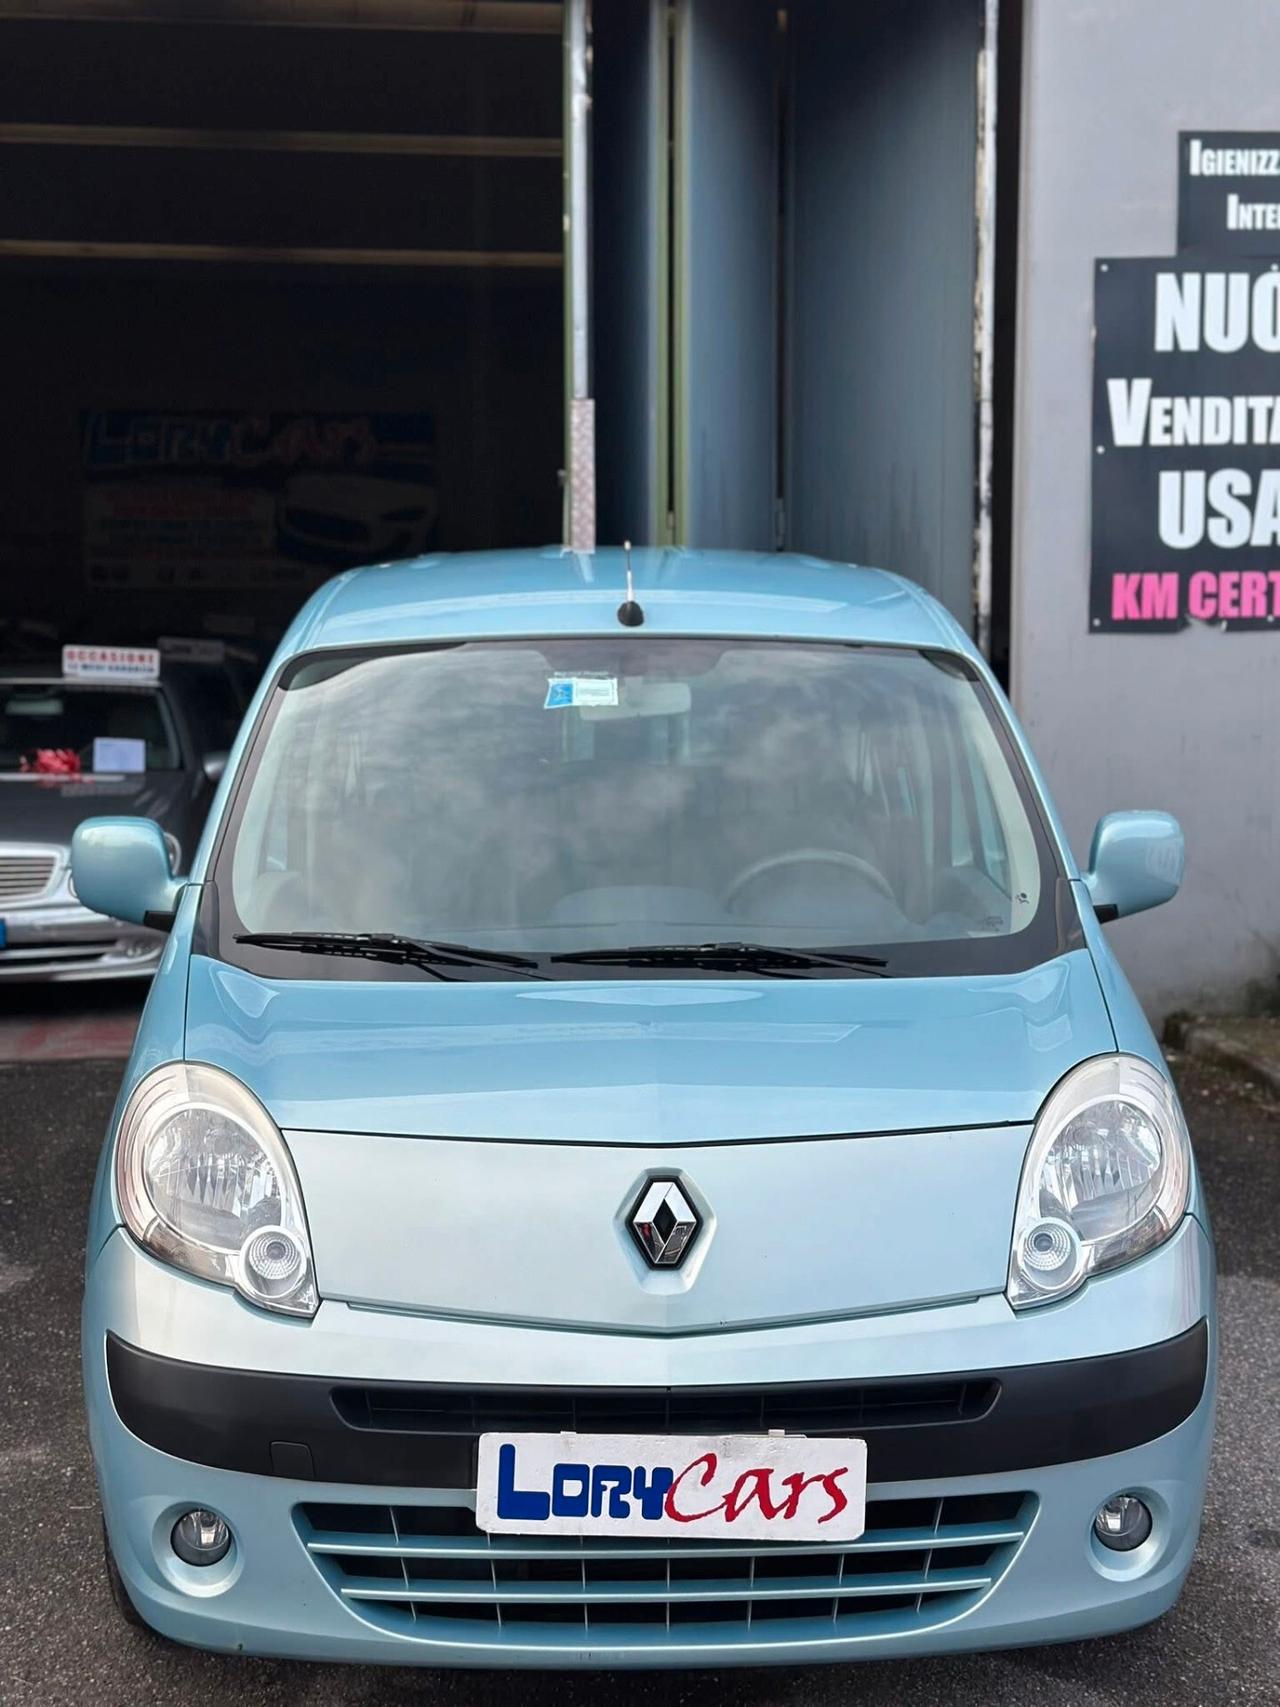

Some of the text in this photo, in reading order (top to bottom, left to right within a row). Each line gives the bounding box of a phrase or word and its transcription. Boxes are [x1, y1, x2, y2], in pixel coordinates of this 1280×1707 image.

[1189, 139, 1280, 176] IGIENIZZ
[1227, 194, 1280, 230] INTE
[1155, 272, 1280, 353] NUO
[1159, 468, 1280, 549] USA
[1112, 572, 1179, 621] KM
